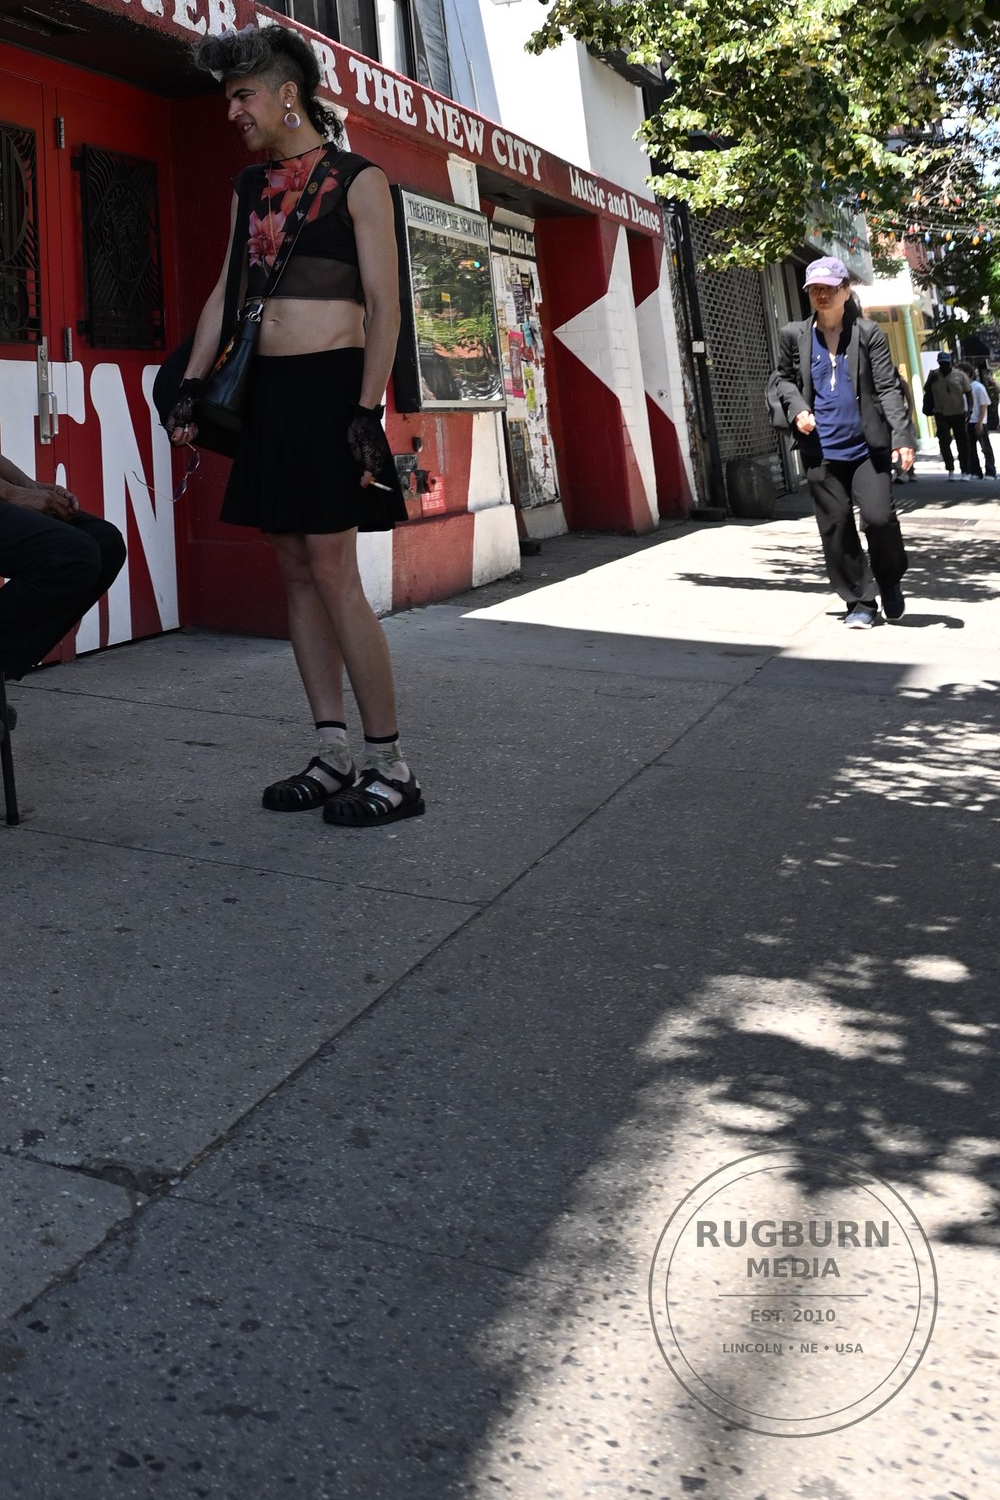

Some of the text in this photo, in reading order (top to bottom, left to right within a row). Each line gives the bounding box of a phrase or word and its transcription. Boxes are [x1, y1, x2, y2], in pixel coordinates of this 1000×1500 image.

[348, 56, 418, 127] THE
[422, 92, 485, 156] NEW
[491, 129, 542, 182] CITY
[408, 200, 435, 225] THEATER
[568, 165, 661, 234] Music and Dance
